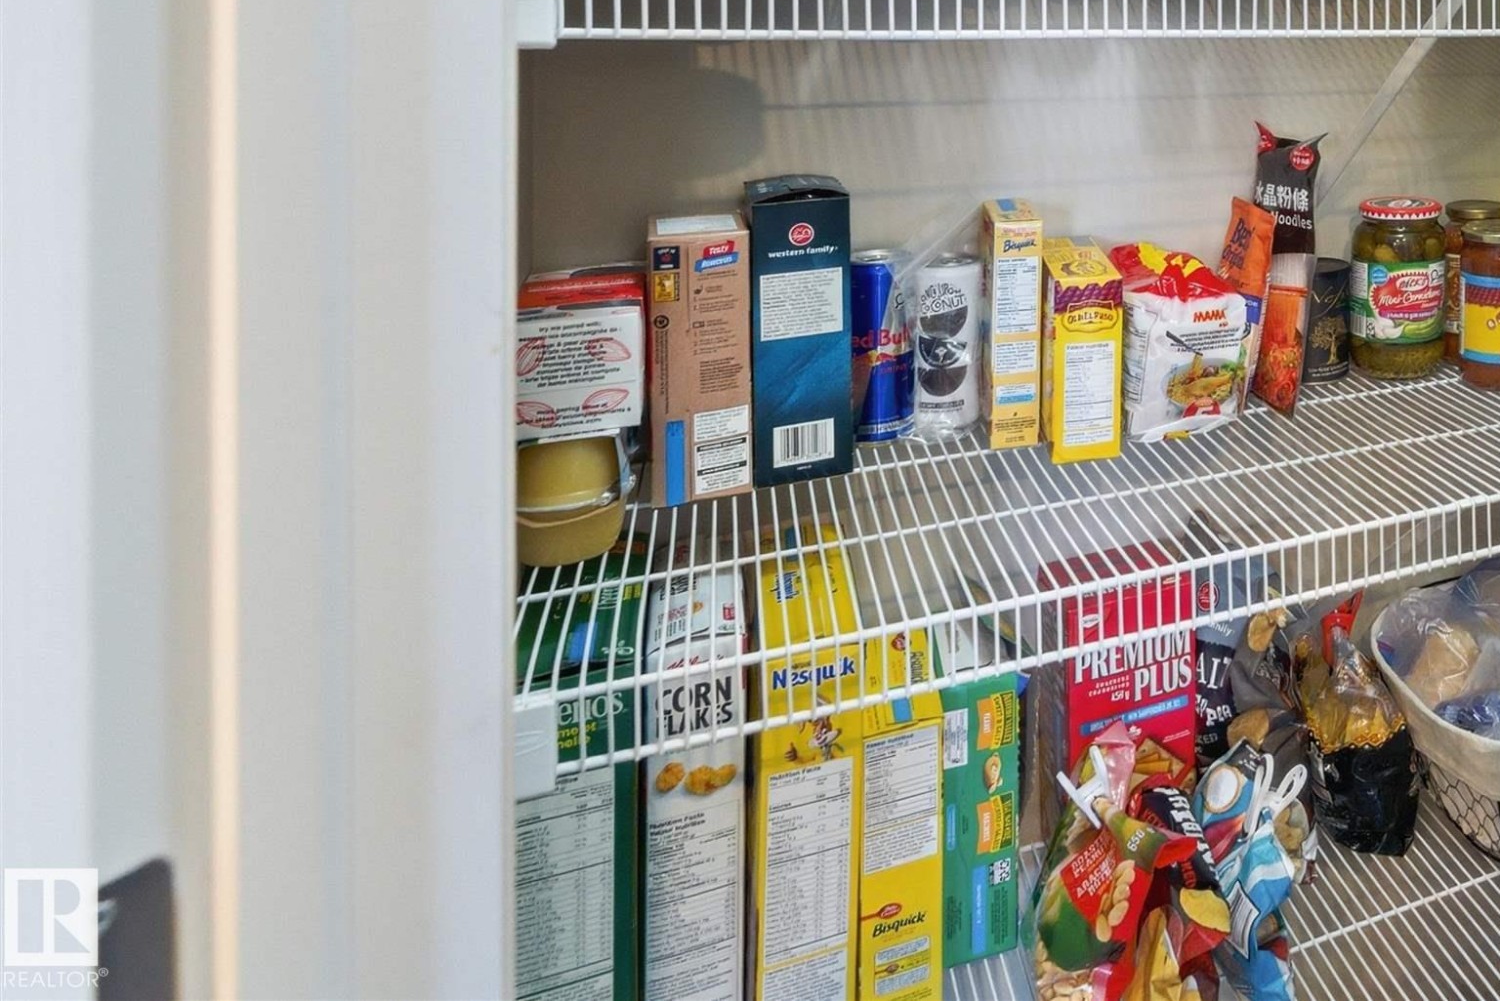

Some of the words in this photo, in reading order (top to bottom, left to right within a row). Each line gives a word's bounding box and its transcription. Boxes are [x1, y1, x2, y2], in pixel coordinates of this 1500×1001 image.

[768, 250, 805, 259] western
[806, 244, 835, 256] family
[920, 293, 966, 315] COCONUT
[1193, 309, 1228, 323] MAMA
[771, 656, 856, 690] Nesquik
[1074, 630, 1192, 684] PREMIUM
[1133, 654, 1193, 702] PLUS
[557, 691, 625, 726] erios
[655, 676, 732, 715] CORN
[656, 702, 734, 738] FLAKES
[872, 911, 927, 939] Bisquick
